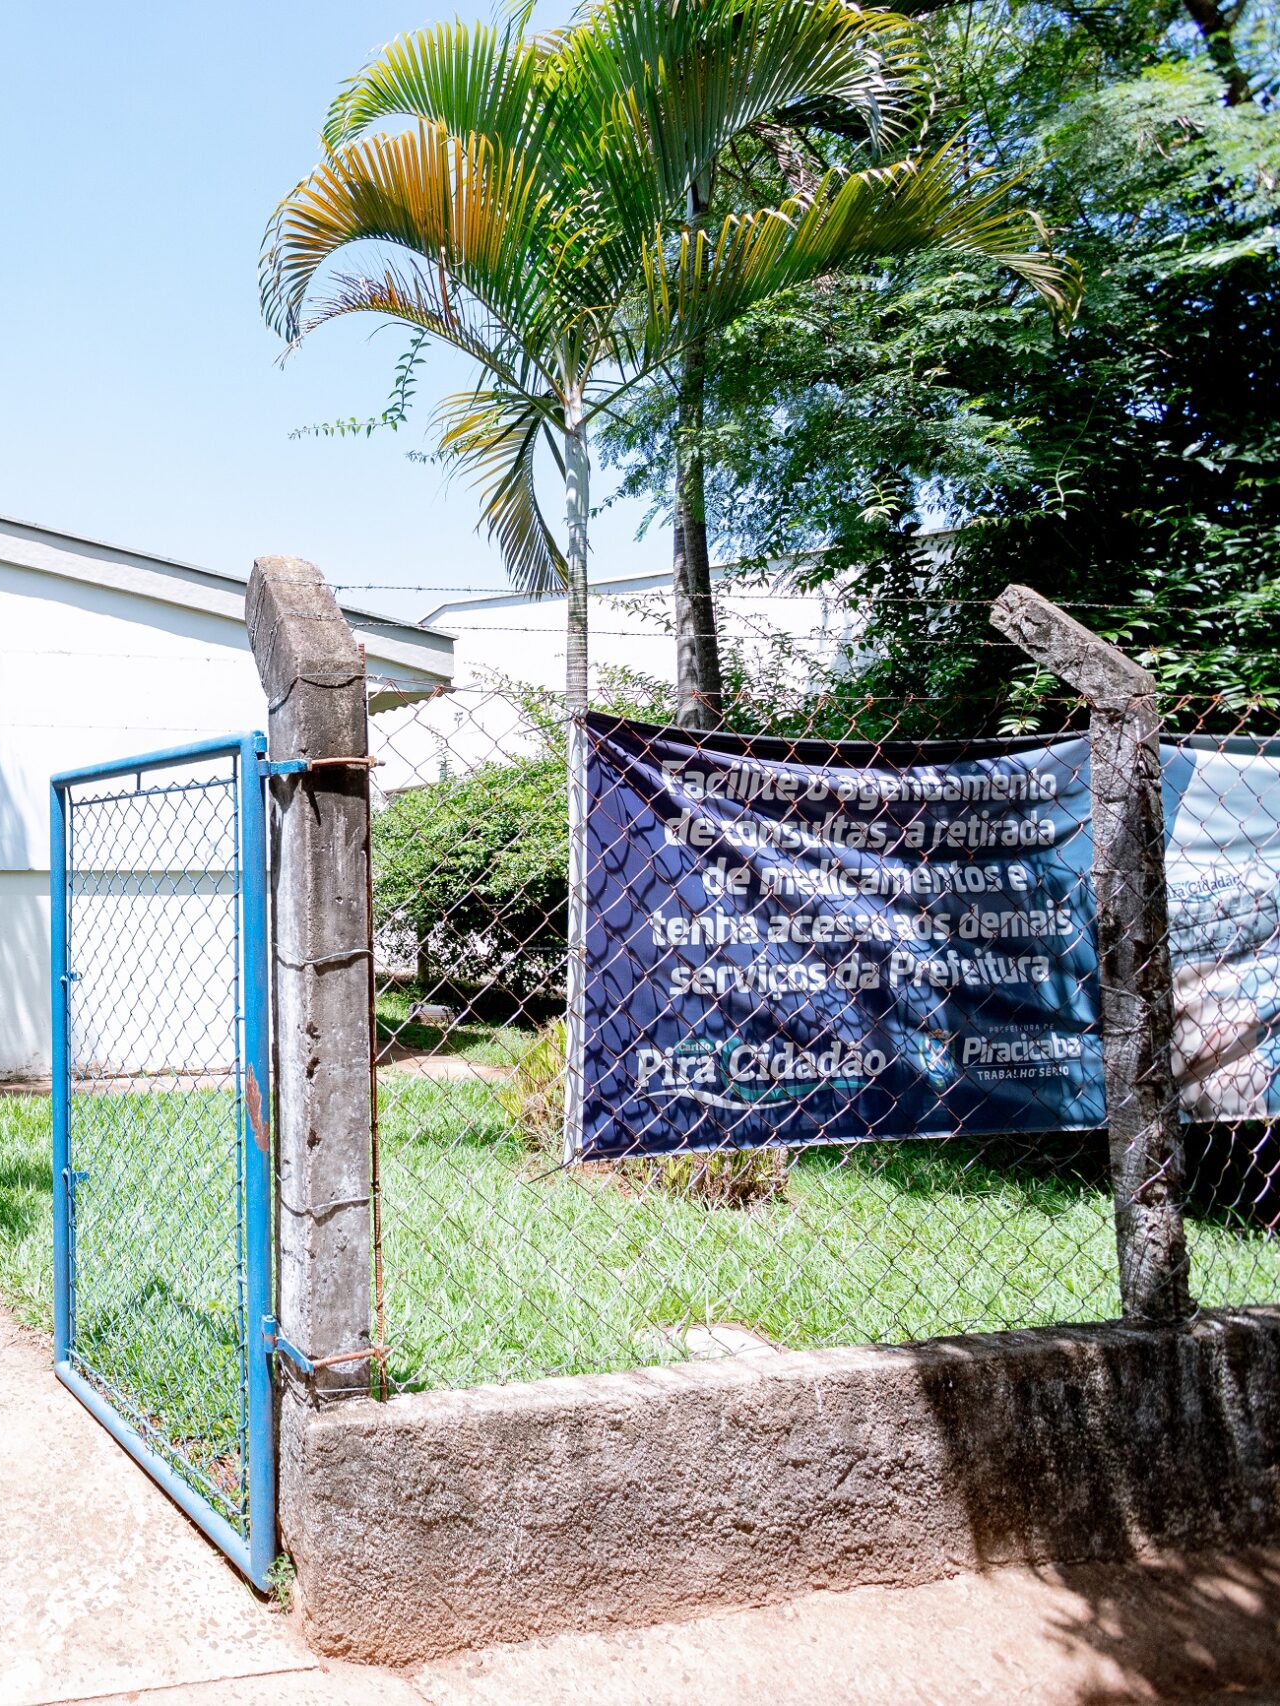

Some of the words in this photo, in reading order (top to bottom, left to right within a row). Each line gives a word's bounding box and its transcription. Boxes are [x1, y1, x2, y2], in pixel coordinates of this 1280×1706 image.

[662, 760, 799, 800] Facilite
[806, 774, 829, 801] o
[837, 767, 1057, 810] agendamento
[664, 808, 715, 847] de
[721, 811, 896, 854] consultas,
[904, 820, 925, 848] a
[933, 810, 1056, 848] retirada
[702, 857, 751, 896] de
[759, 858, 1003, 896] medicamentos
[1007, 863, 1028, 893] e
[650, 906, 759, 946] tenha
[767, 914, 891, 944] acesso
[895, 912, 952, 941] aos
[958, 900, 1073, 939] demais
[669, 954, 827, 1000] serviços
[835, 952, 880, 990] da
[889, 948, 1050, 988] Prefeitura
[634, 1046, 717, 1087] Pira
[728, 1040, 887, 1083] Cidadão
[962, 1031, 1082, 1065] Piracicaba
[977, 1067, 1035, 1082] TRABALHO
[1038, 1064, 1070, 1078] SÉRIO
